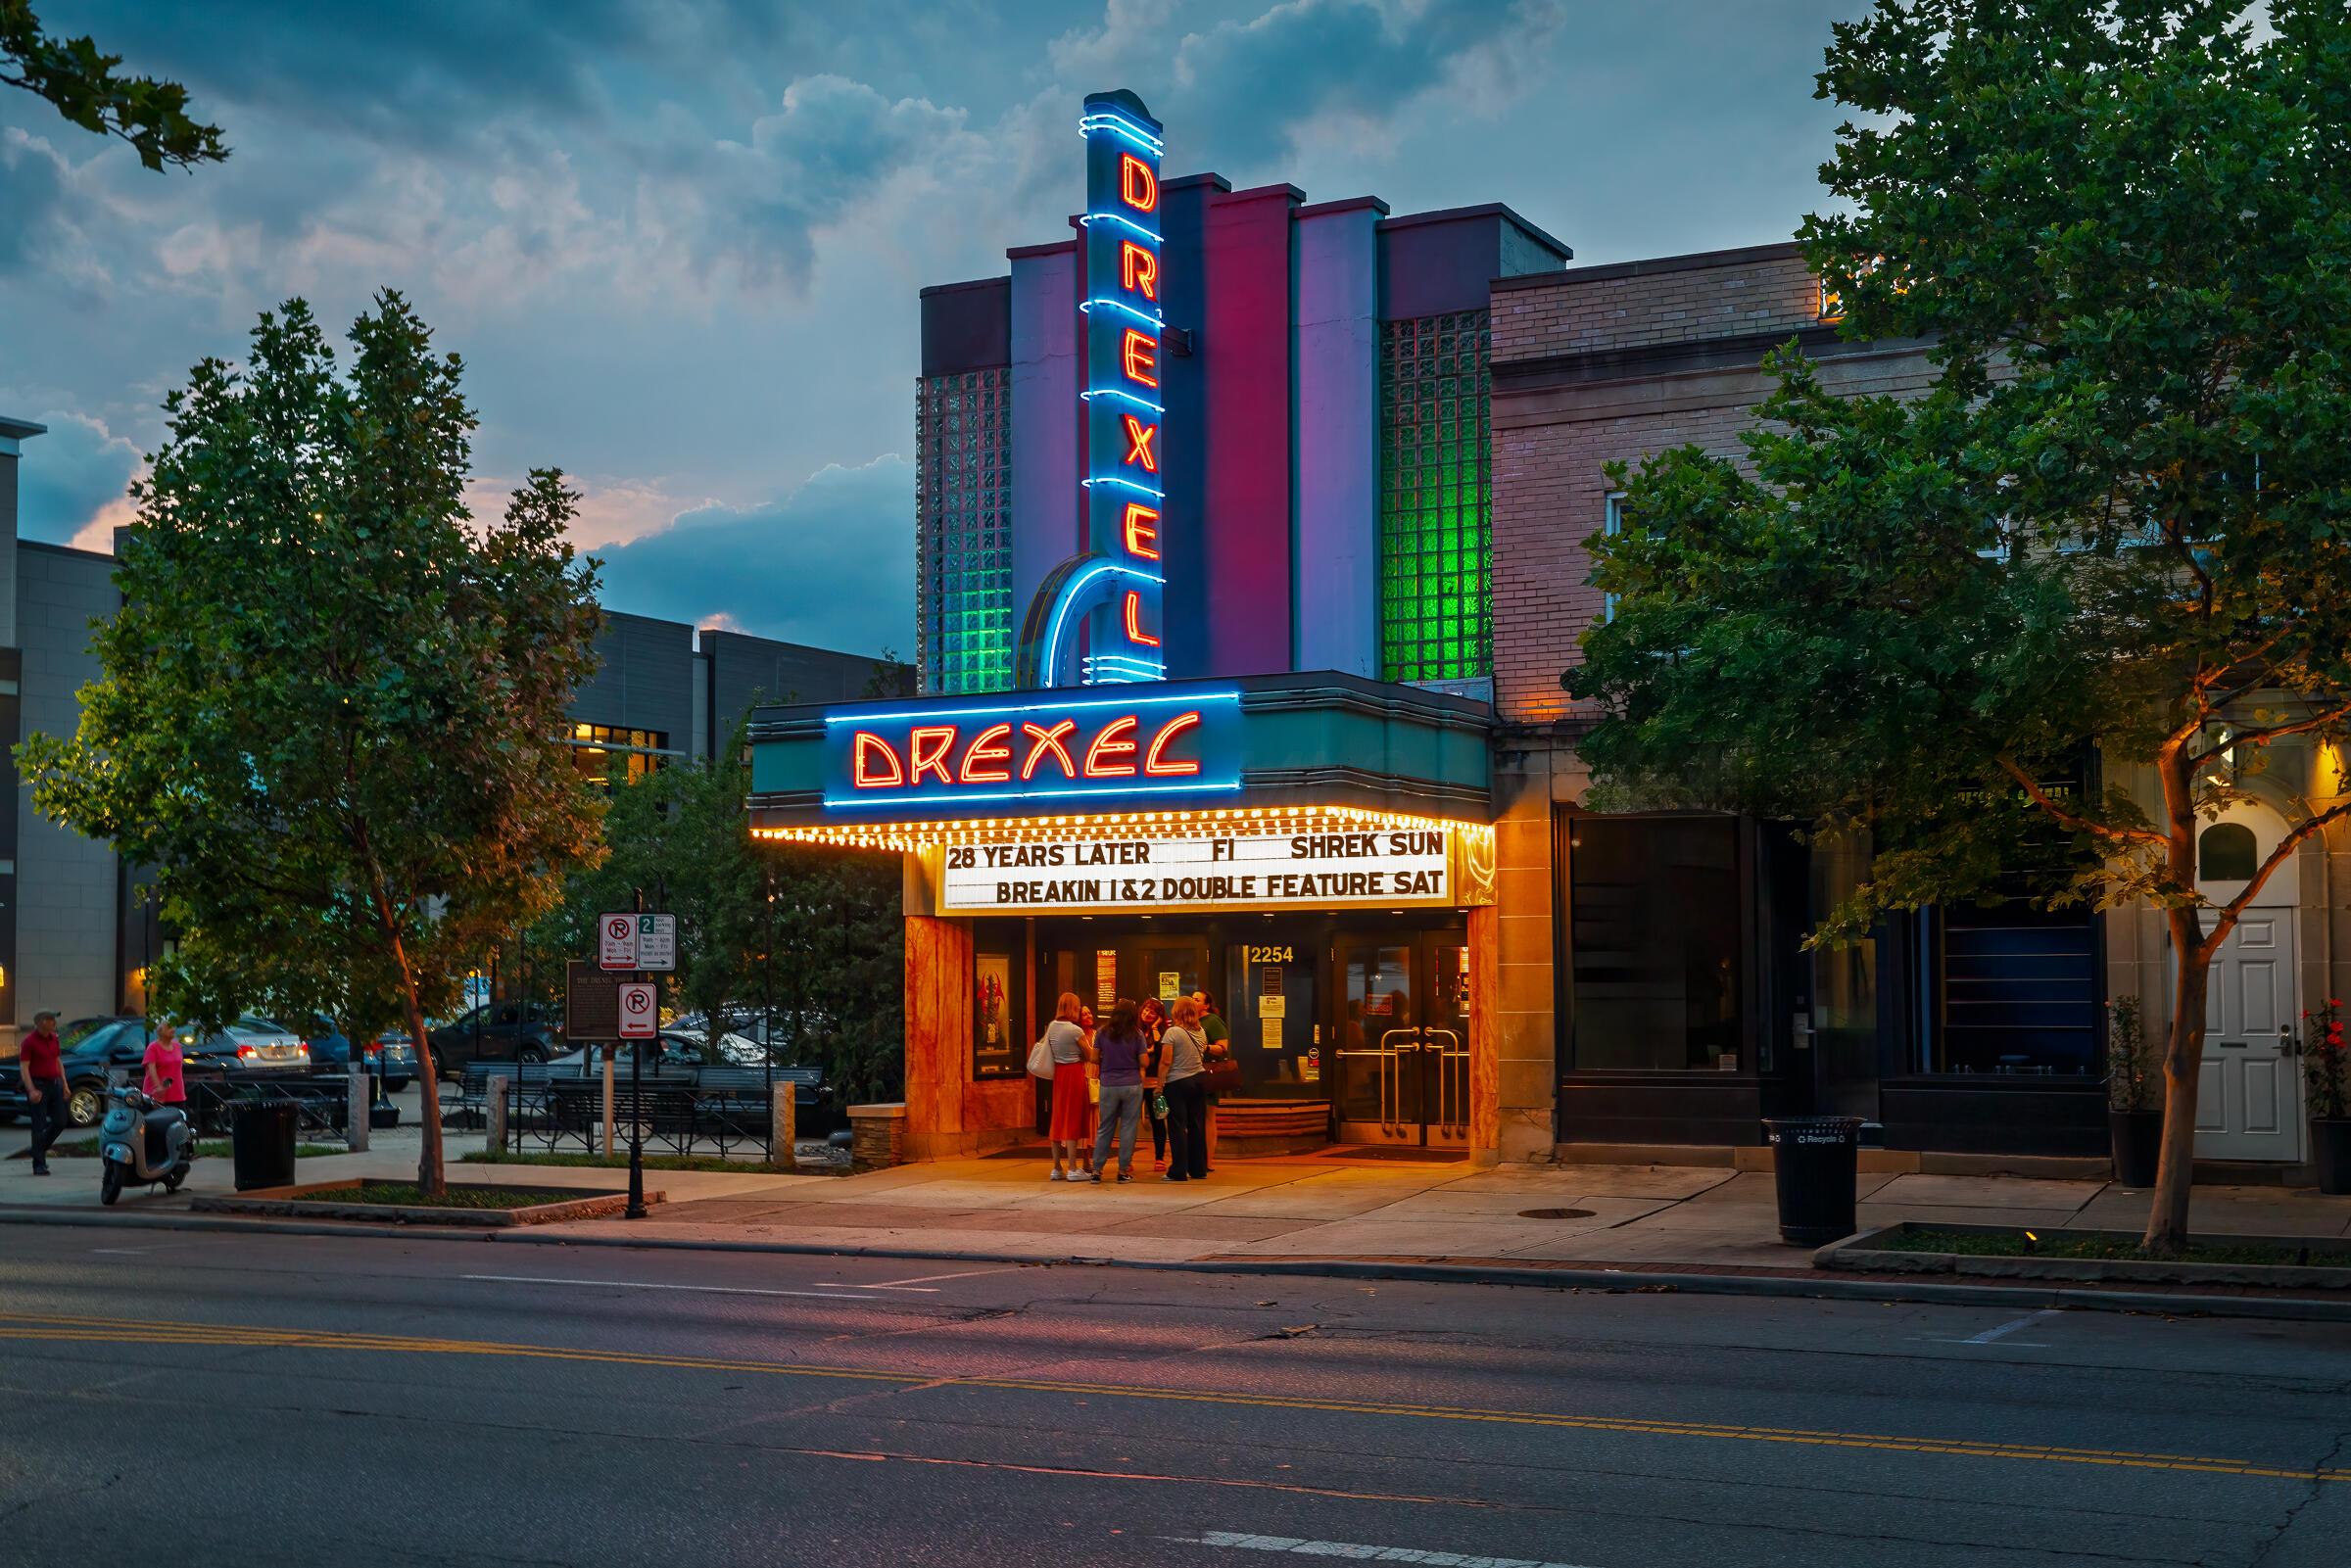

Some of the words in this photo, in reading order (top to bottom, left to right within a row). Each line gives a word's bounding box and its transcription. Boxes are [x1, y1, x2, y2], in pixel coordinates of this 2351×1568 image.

[1120, 152, 1160, 647] DREXEL
[854, 710, 1202, 788] DREXEL
[947, 847, 976, 869] 28
[983, 844, 1064, 868] YEARS
[1075, 841, 1150, 866] LATER
[1291, 833, 1379, 859] SHREK
[1389, 832, 1443, 856] SUN
[996, 879, 1100, 903] BREAKIN
[1163, 876, 1256, 900] DOUBLE
[1268, 872, 1384, 897] FEATURE
[1394, 870, 1443, 894] SAT
[643, 918, 650, 932] 2
[1251, 946, 1293, 963] 2254
[1807, 1135, 1837, 1144] Recycle
